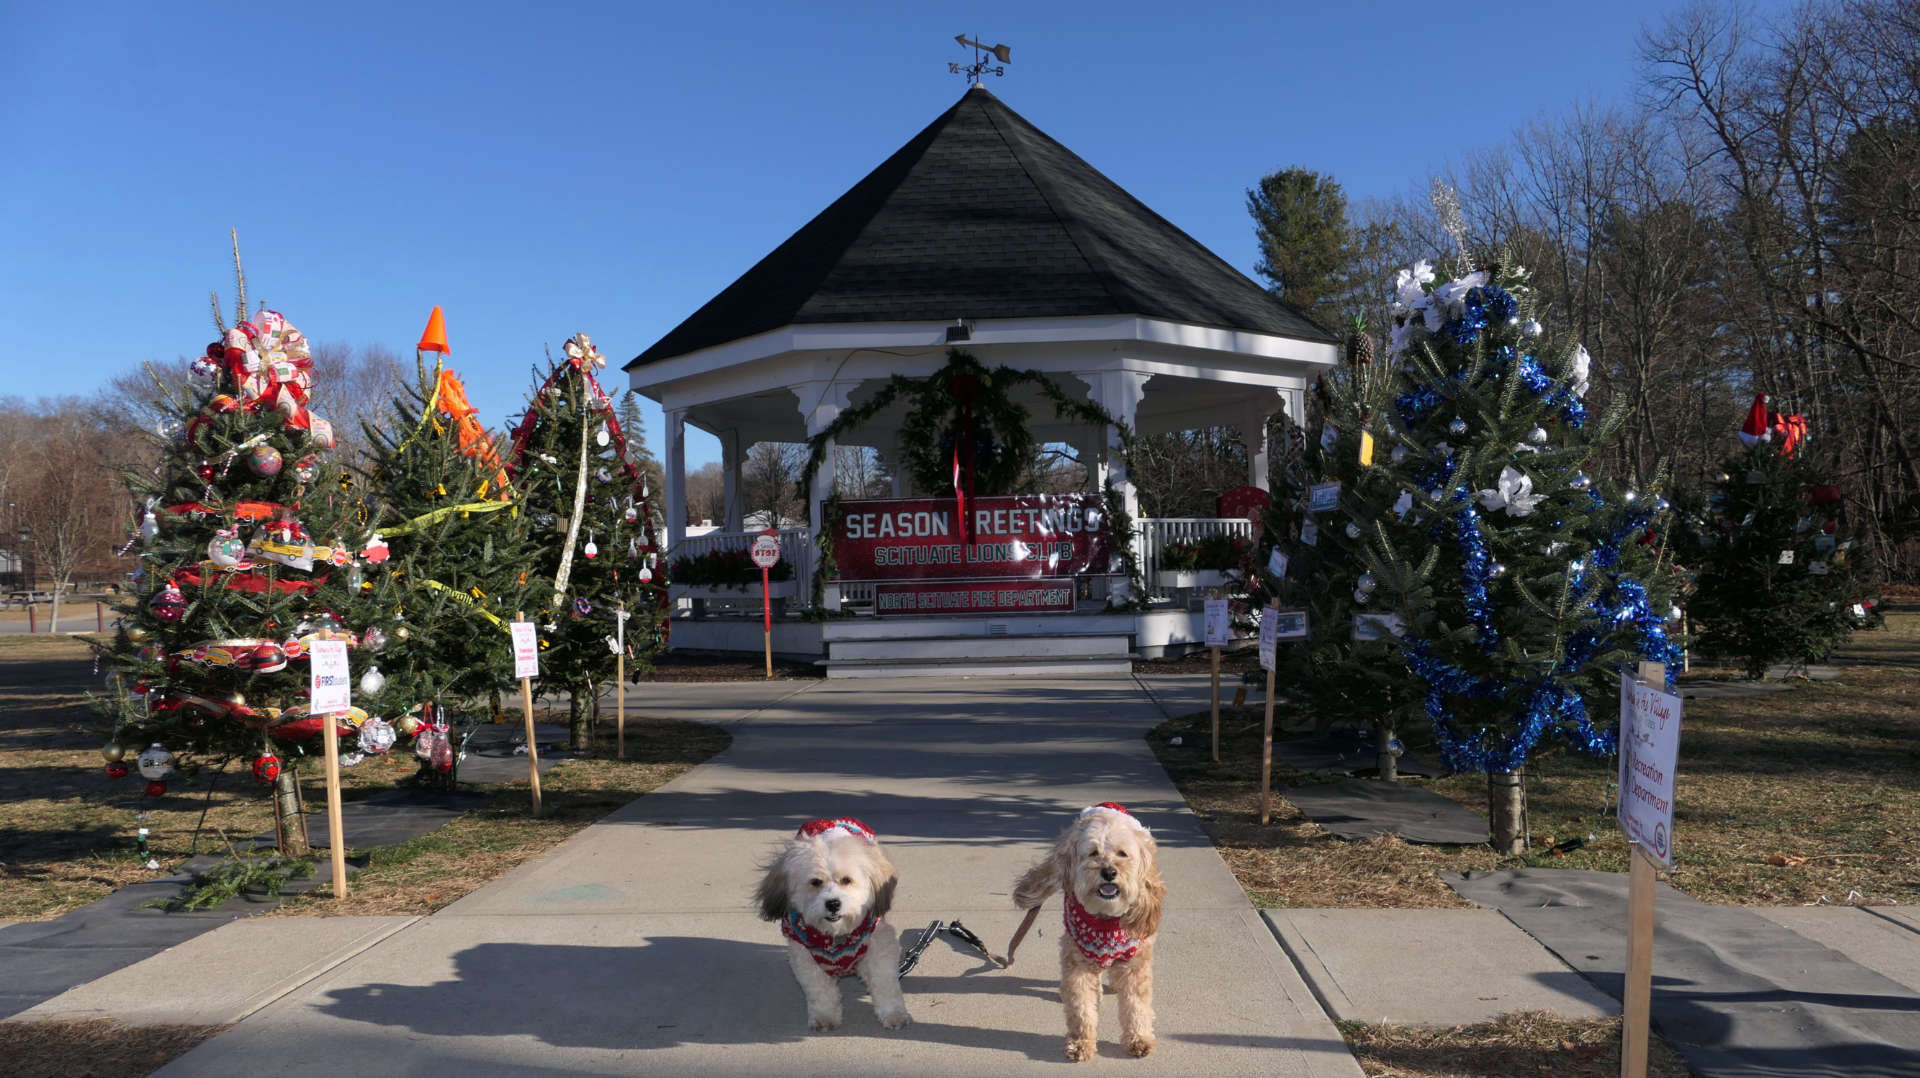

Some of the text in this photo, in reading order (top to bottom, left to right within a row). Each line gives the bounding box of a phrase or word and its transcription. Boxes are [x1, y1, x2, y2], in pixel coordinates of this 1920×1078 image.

[846, 506, 1100, 539] SEASON REETINGS
[874, 544, 962, 566] SCITUATE
[1025, 541, 1073, 562] CLUB
[879, 588, 1070, 609] NORTH SCITUATE FIRE DEPARTMENT
[1631, 775, 1669, 816] Department
